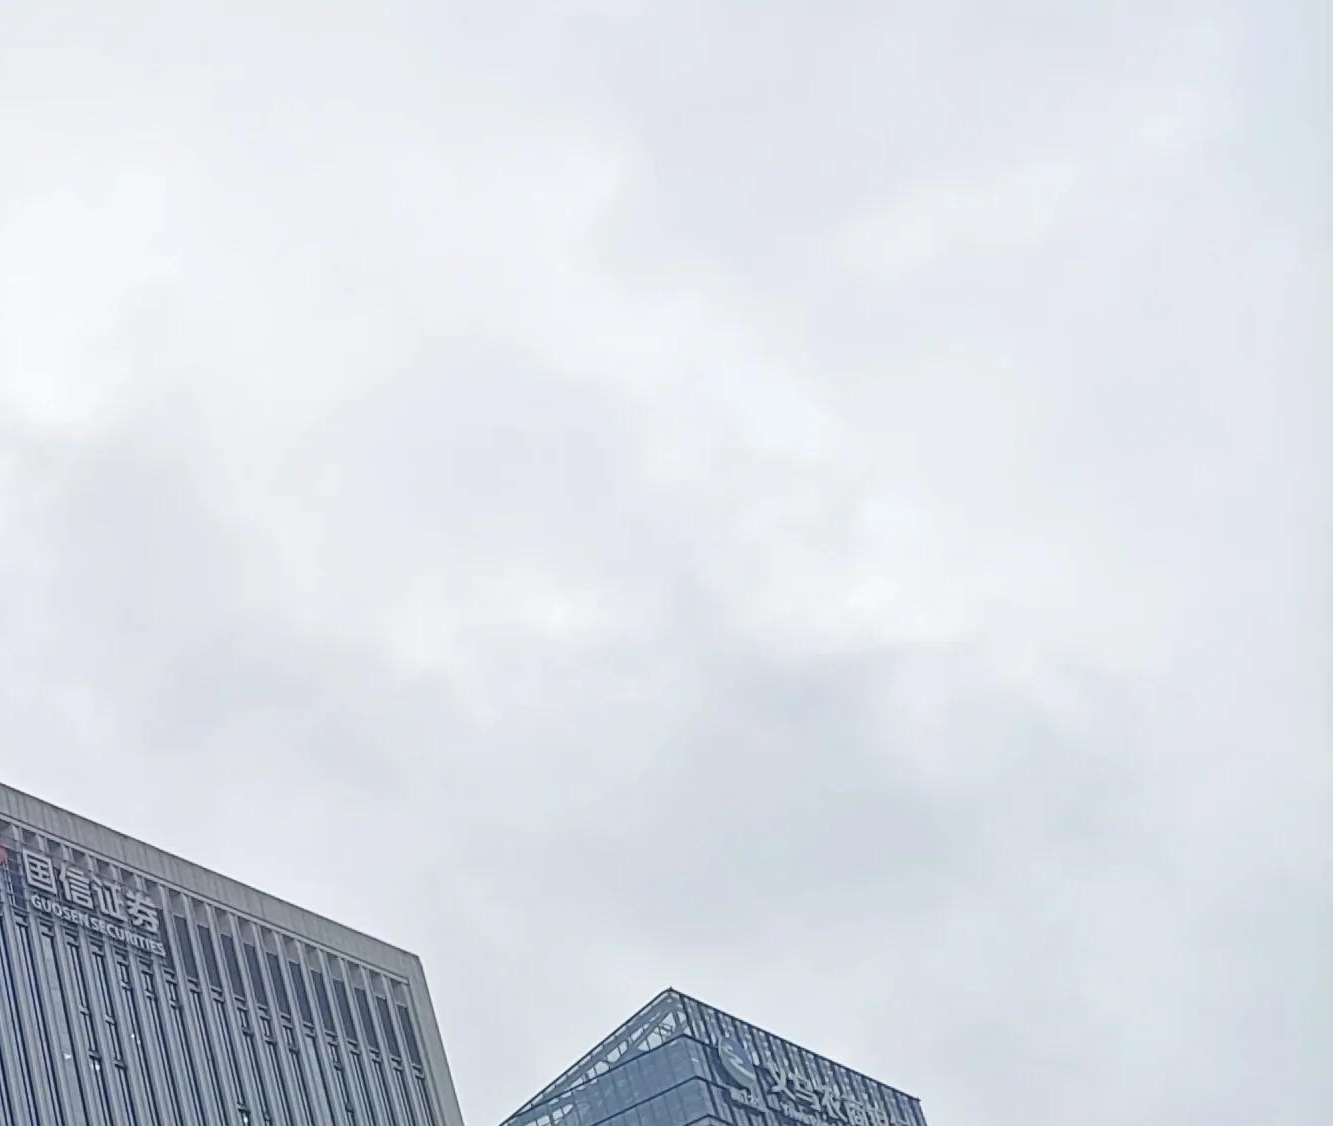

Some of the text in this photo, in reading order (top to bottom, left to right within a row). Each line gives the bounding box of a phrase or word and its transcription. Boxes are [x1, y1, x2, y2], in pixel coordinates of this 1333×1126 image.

[23, 849, 159, 934] 国信证券
[32, 894, 166, 958] GUOSEN SECURITIES
